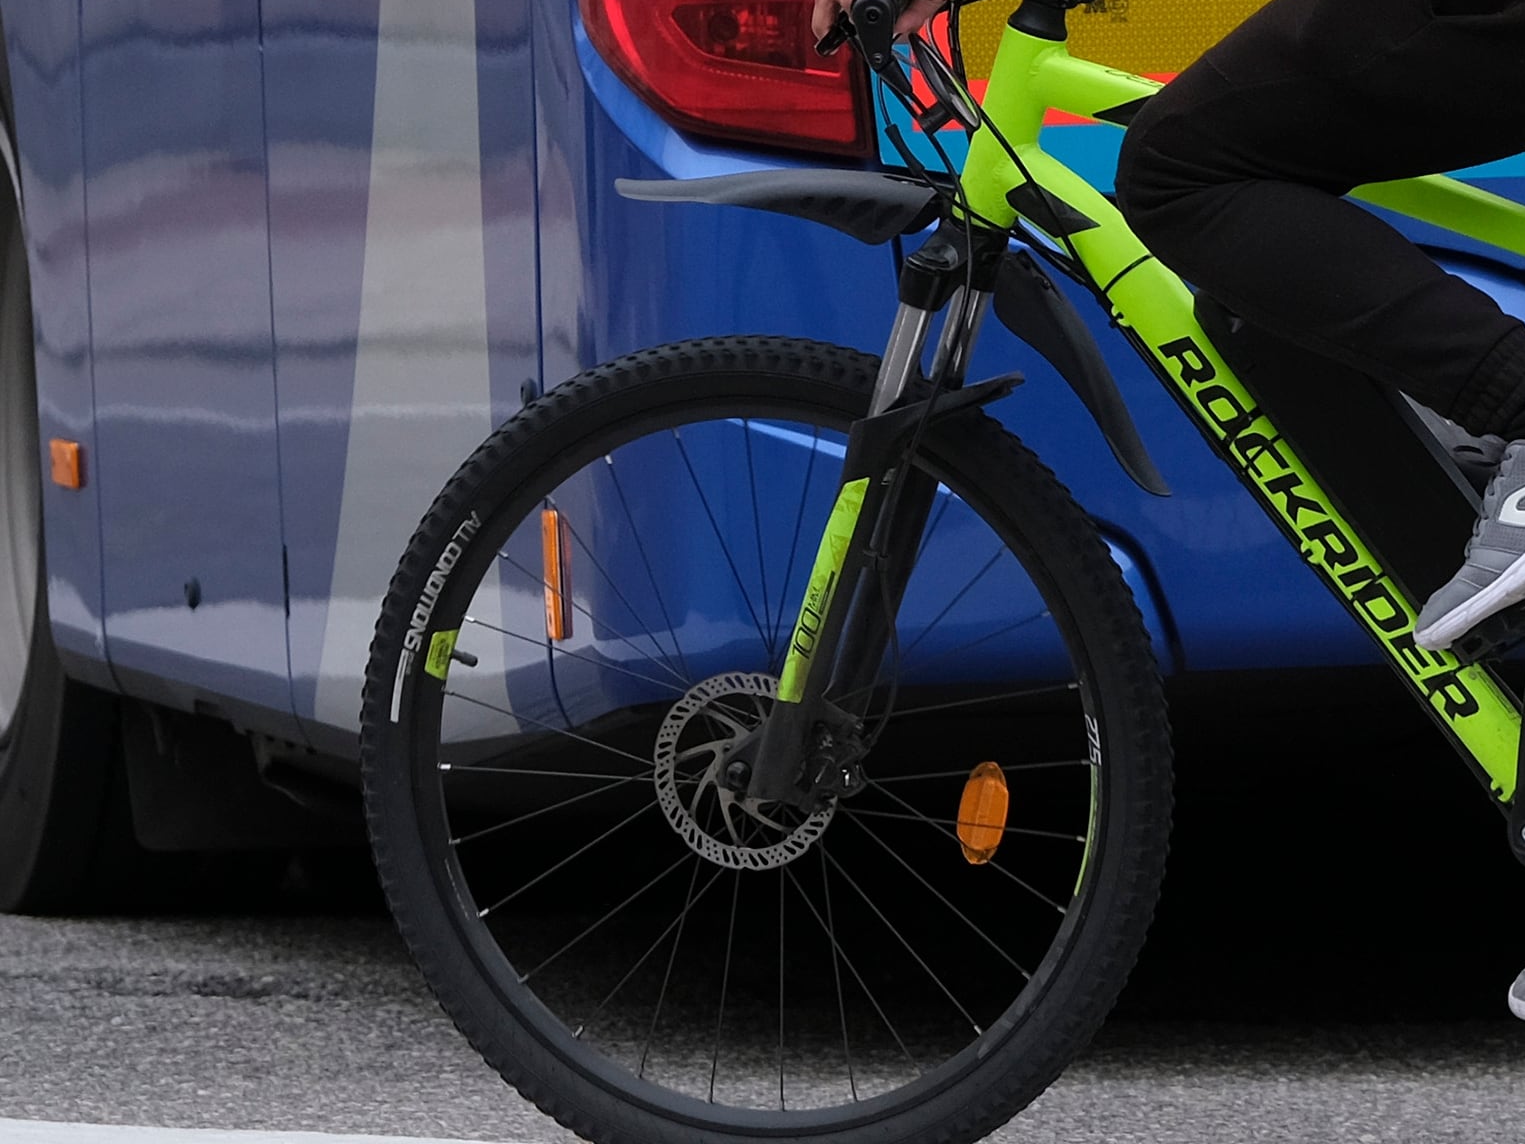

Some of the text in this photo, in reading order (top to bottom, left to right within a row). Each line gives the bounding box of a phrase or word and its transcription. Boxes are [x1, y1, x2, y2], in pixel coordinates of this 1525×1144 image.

[451, 510, 483, 544] ALL
[1157, 335, 1480, 722] ROCKRIDER
[403, 541, 462, 653] CONDITIONS
[792, 606, 821, 660] 100
